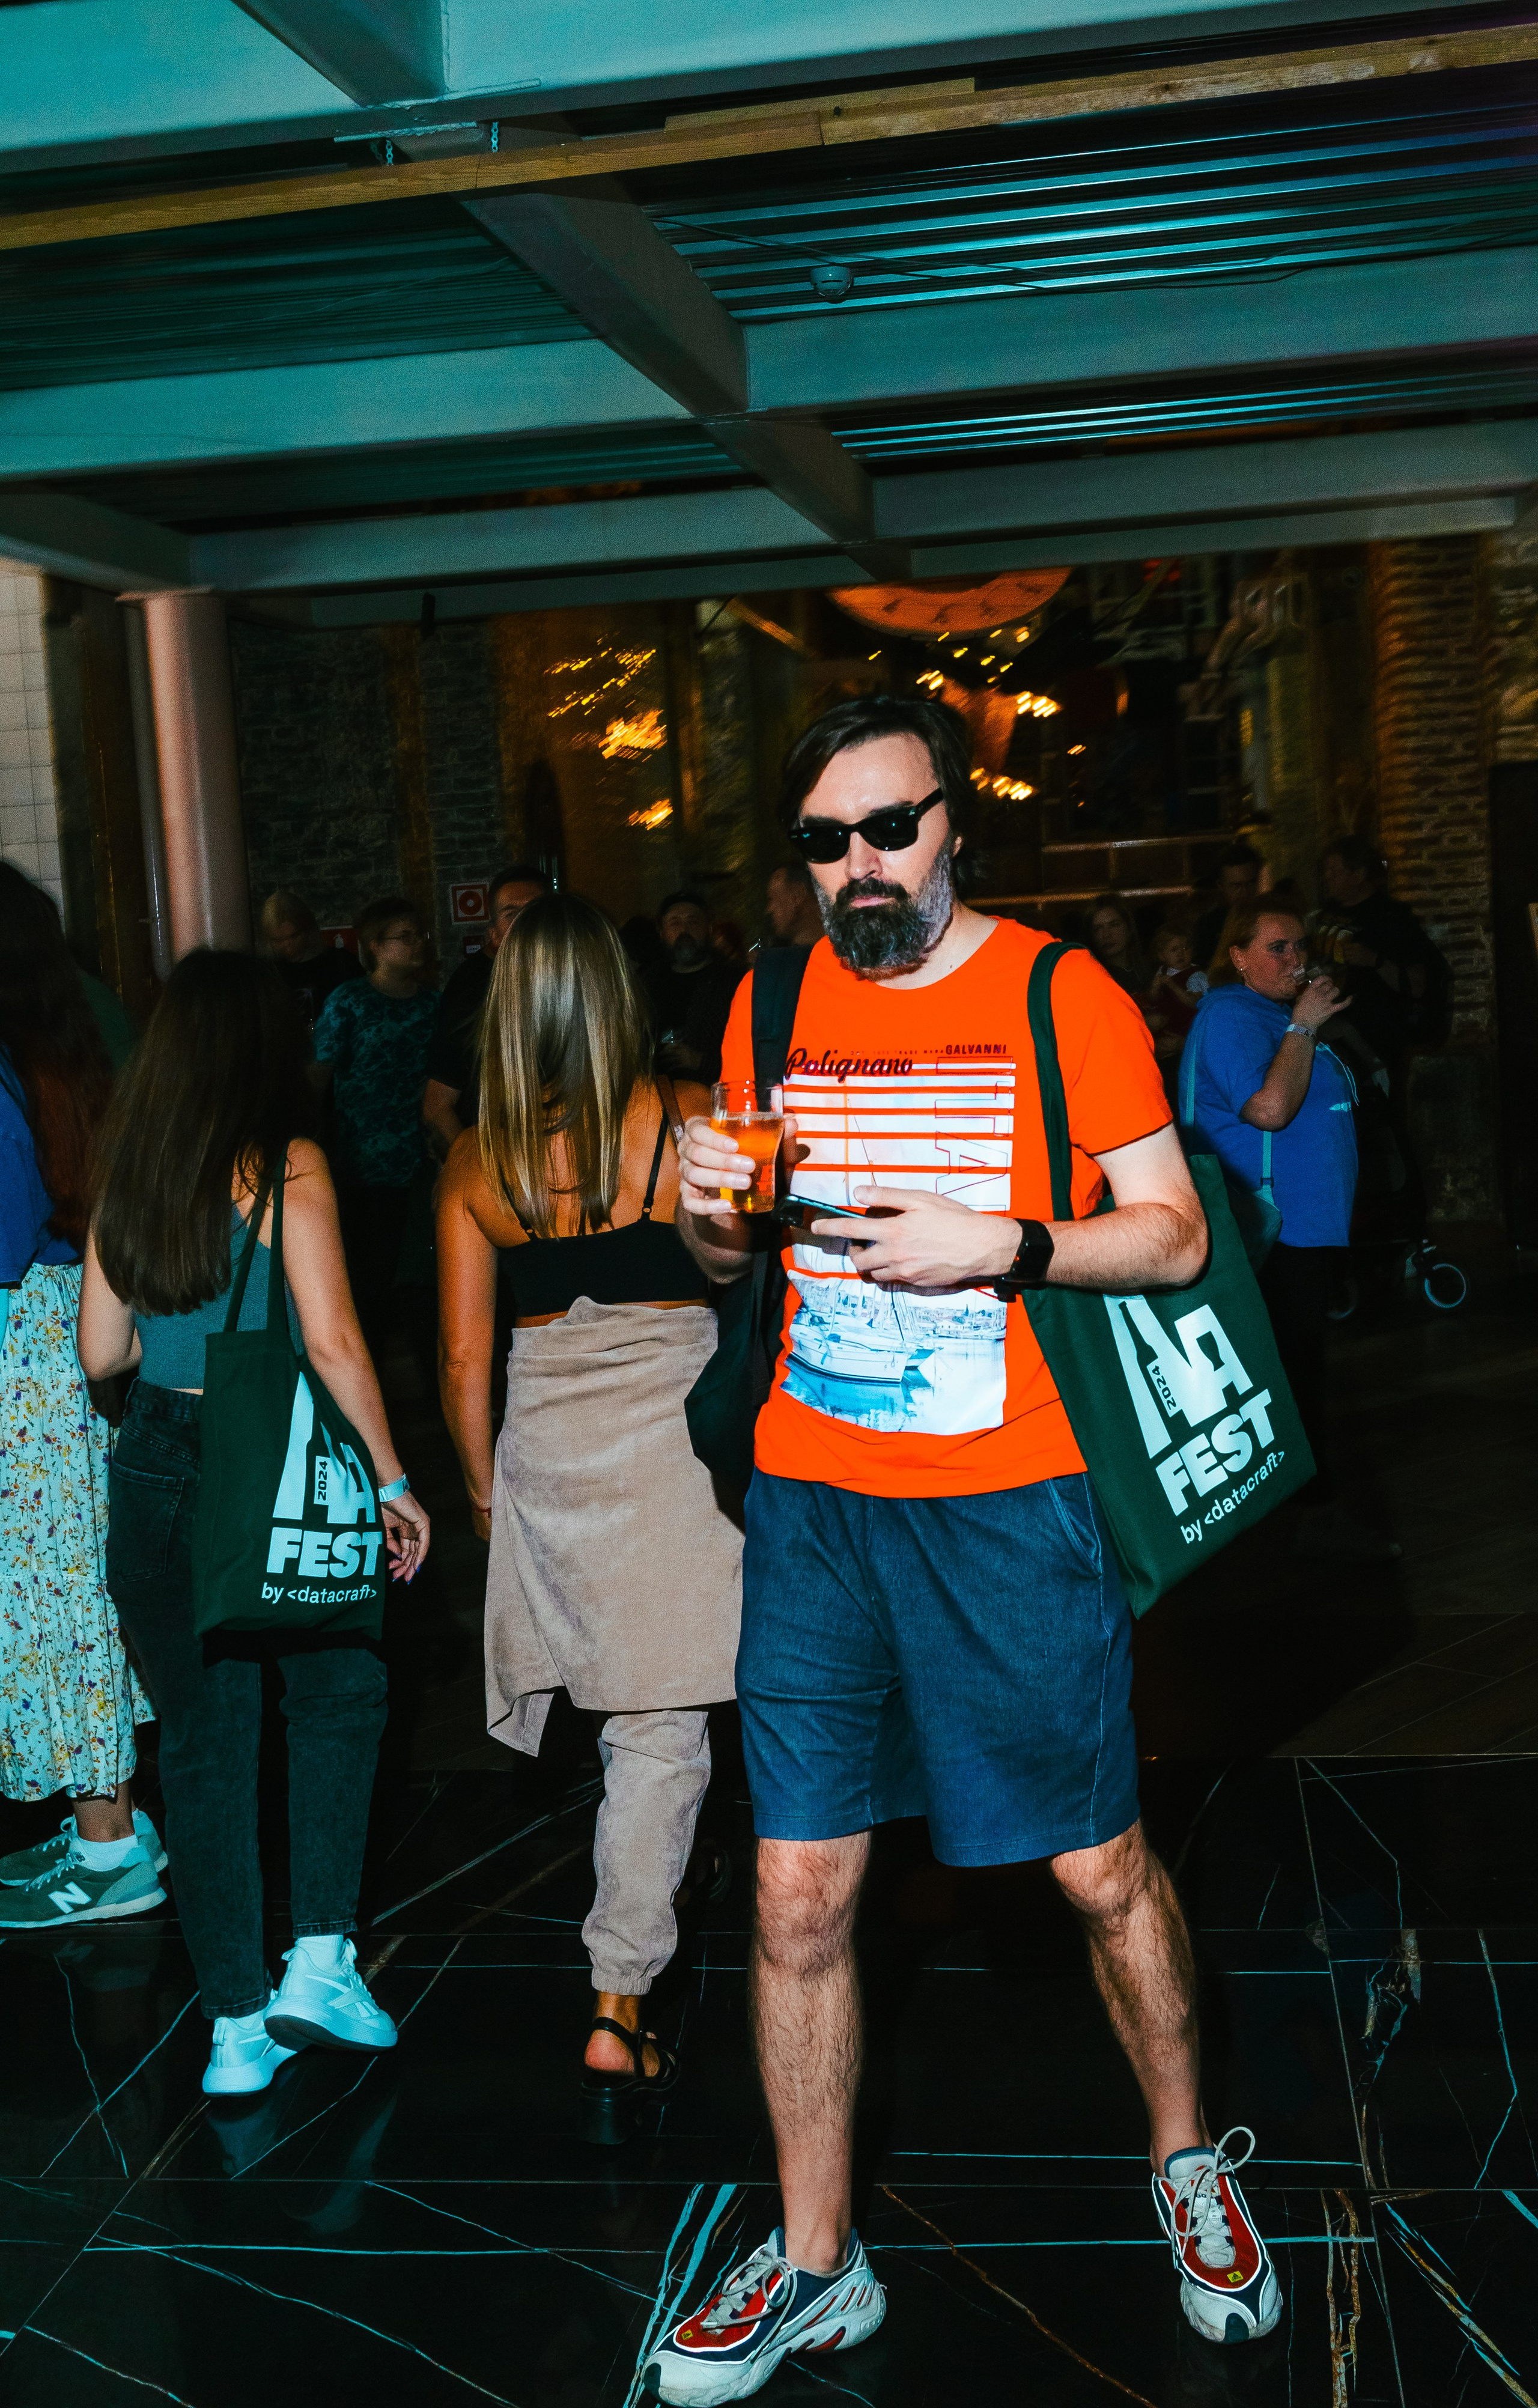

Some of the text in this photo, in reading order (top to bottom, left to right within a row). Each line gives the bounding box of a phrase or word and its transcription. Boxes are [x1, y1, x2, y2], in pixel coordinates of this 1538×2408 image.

[785, 1048, 913, 1083] Polignano
[945, 1044, 1007, 1055] GALVANNI
[1151, 1364, 1178, 1411] 2024
[1155, 1388, 1275, 1517] FEST
[317, 1460, 328, 1501] 2024
[1180, 1450, 1286, 1544] by <datacraft>
[266, 1527, 383, 1578] FEST
[261, 1582, 377, 1604] by <datacraft>
[47, 1880, 93, 1914] N
